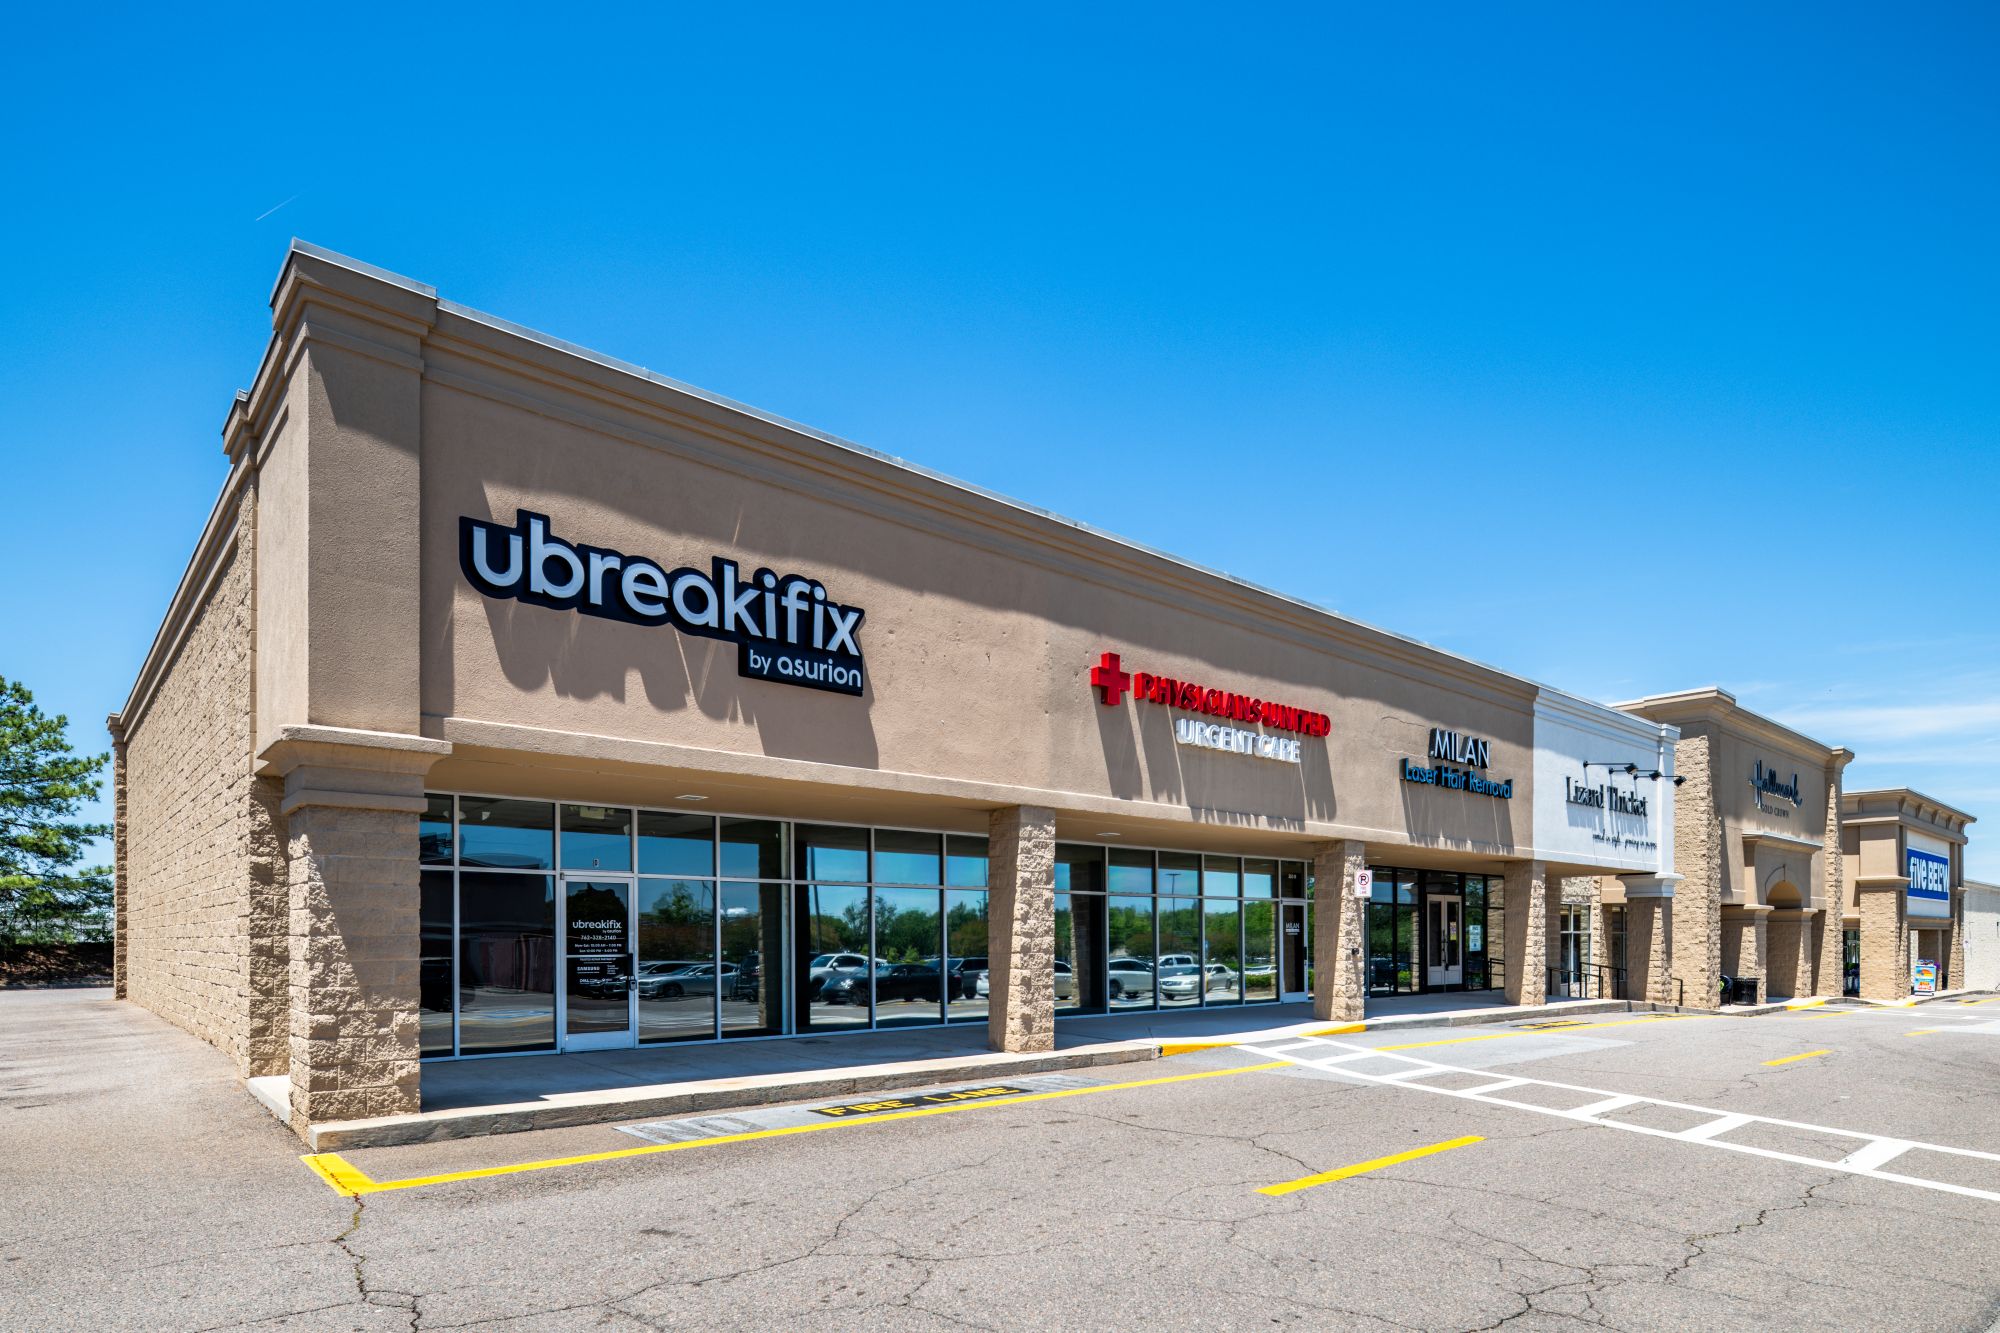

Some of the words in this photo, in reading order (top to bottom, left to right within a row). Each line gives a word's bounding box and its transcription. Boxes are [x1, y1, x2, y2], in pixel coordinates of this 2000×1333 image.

[472, 517, 860, 656] ubreakifix
[749, 648, 771, 675] by
[776, 656, 862, 688] asurion
[1134, 672, 1263, 724] PHYSICIANS
[1261, 702, 1332, 738] UNITED
[1176, 718, 1257, 756] URGENT
[1428, 727, 1491, 770] MILAN
[1399, 758, 1438, 785] Laser
[1440, 765, 1467, 792] Hair
[1468, 771, 1513, 799] Removal
[1565, 776, 1605, 809] Lizard
[1608, 785, 1648, 817] Thicket
[1749, 759, 1803, 808] Hallmark
[572, 919, 622, 929] ubreakifix
[820, 1100, 915, 1116] FIRE
[923, 1086, 1021, 1102] LANE
